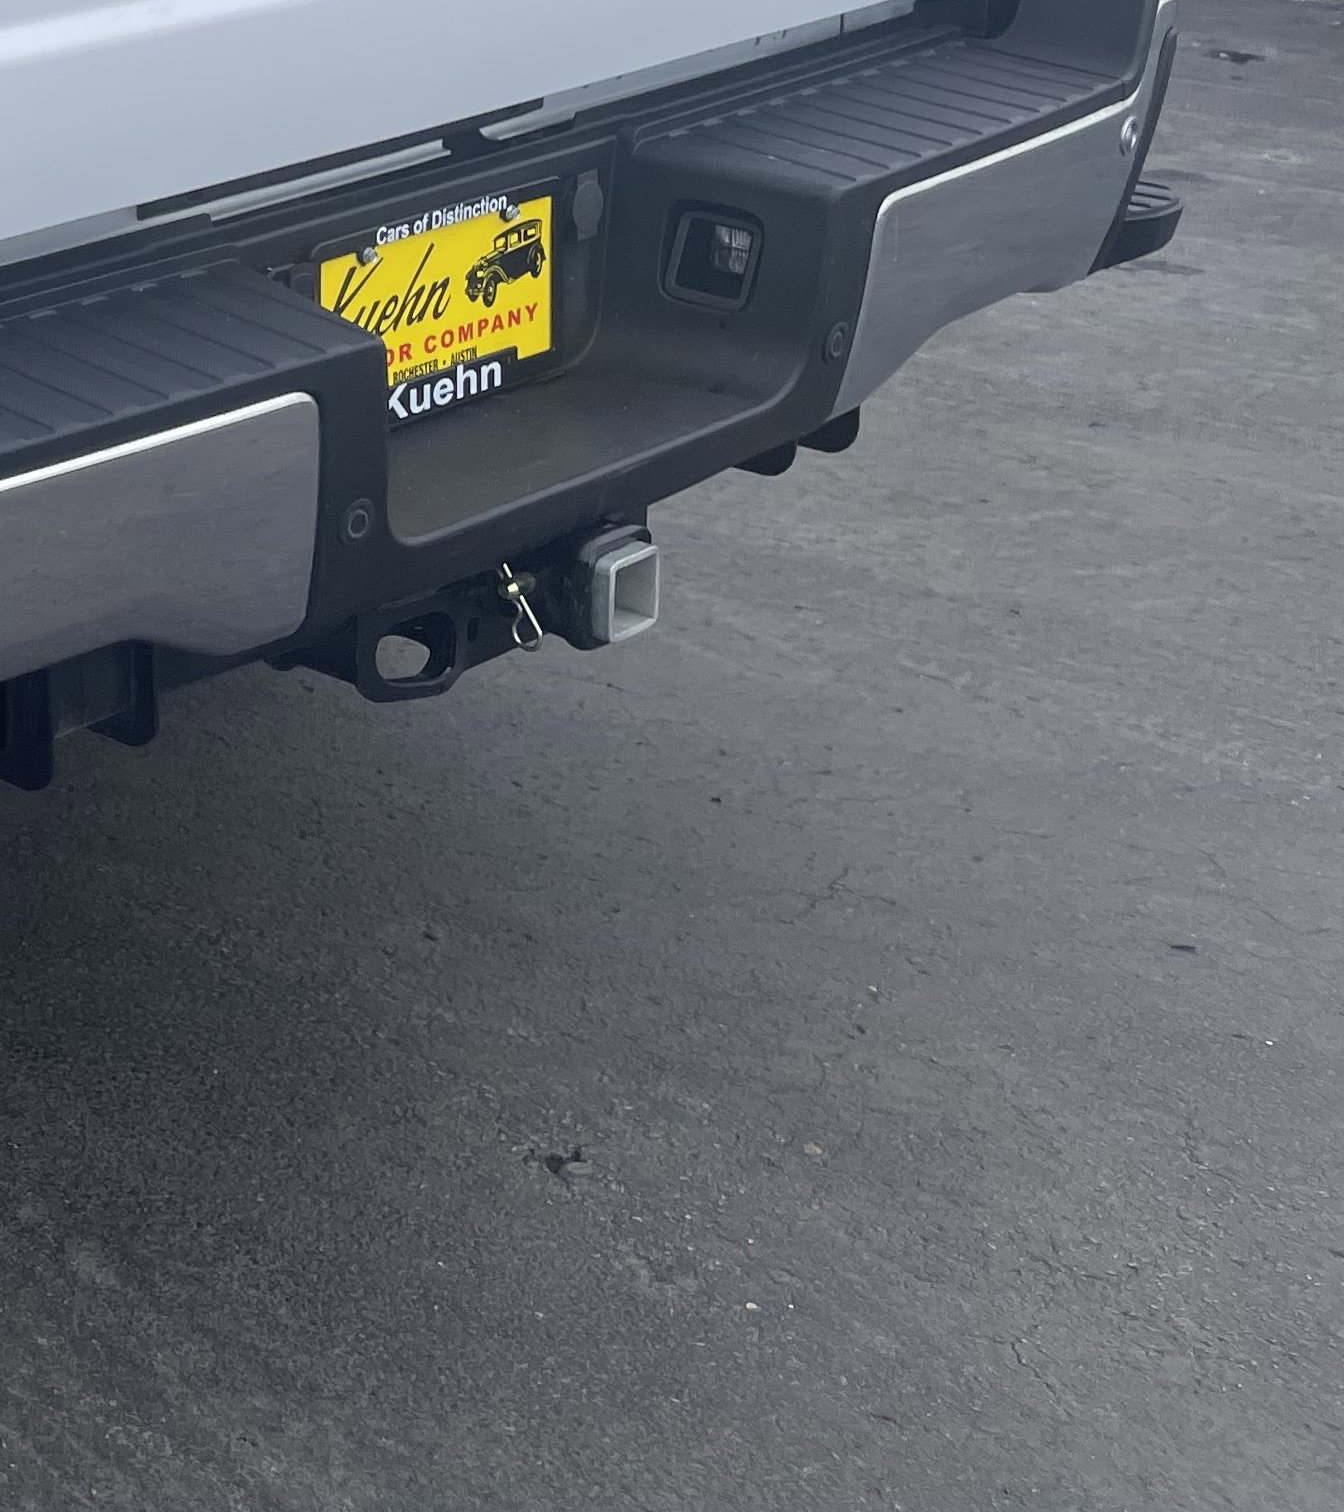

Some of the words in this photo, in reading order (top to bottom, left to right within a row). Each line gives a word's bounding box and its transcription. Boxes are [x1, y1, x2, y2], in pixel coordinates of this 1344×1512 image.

[376, 225, 410, 245] Cars
[413, 212, 430, 235] of
[431, 195, 508, 230] Distinction
[331, 242, 452, 337] Kuehn
[423, 302, 539, 355] COMPANY
[387, 360, 503, 420] Kuehn
[392, 358, 440, 384] ROCHESTER
[450, 345, 479, 366] AUSTIN
